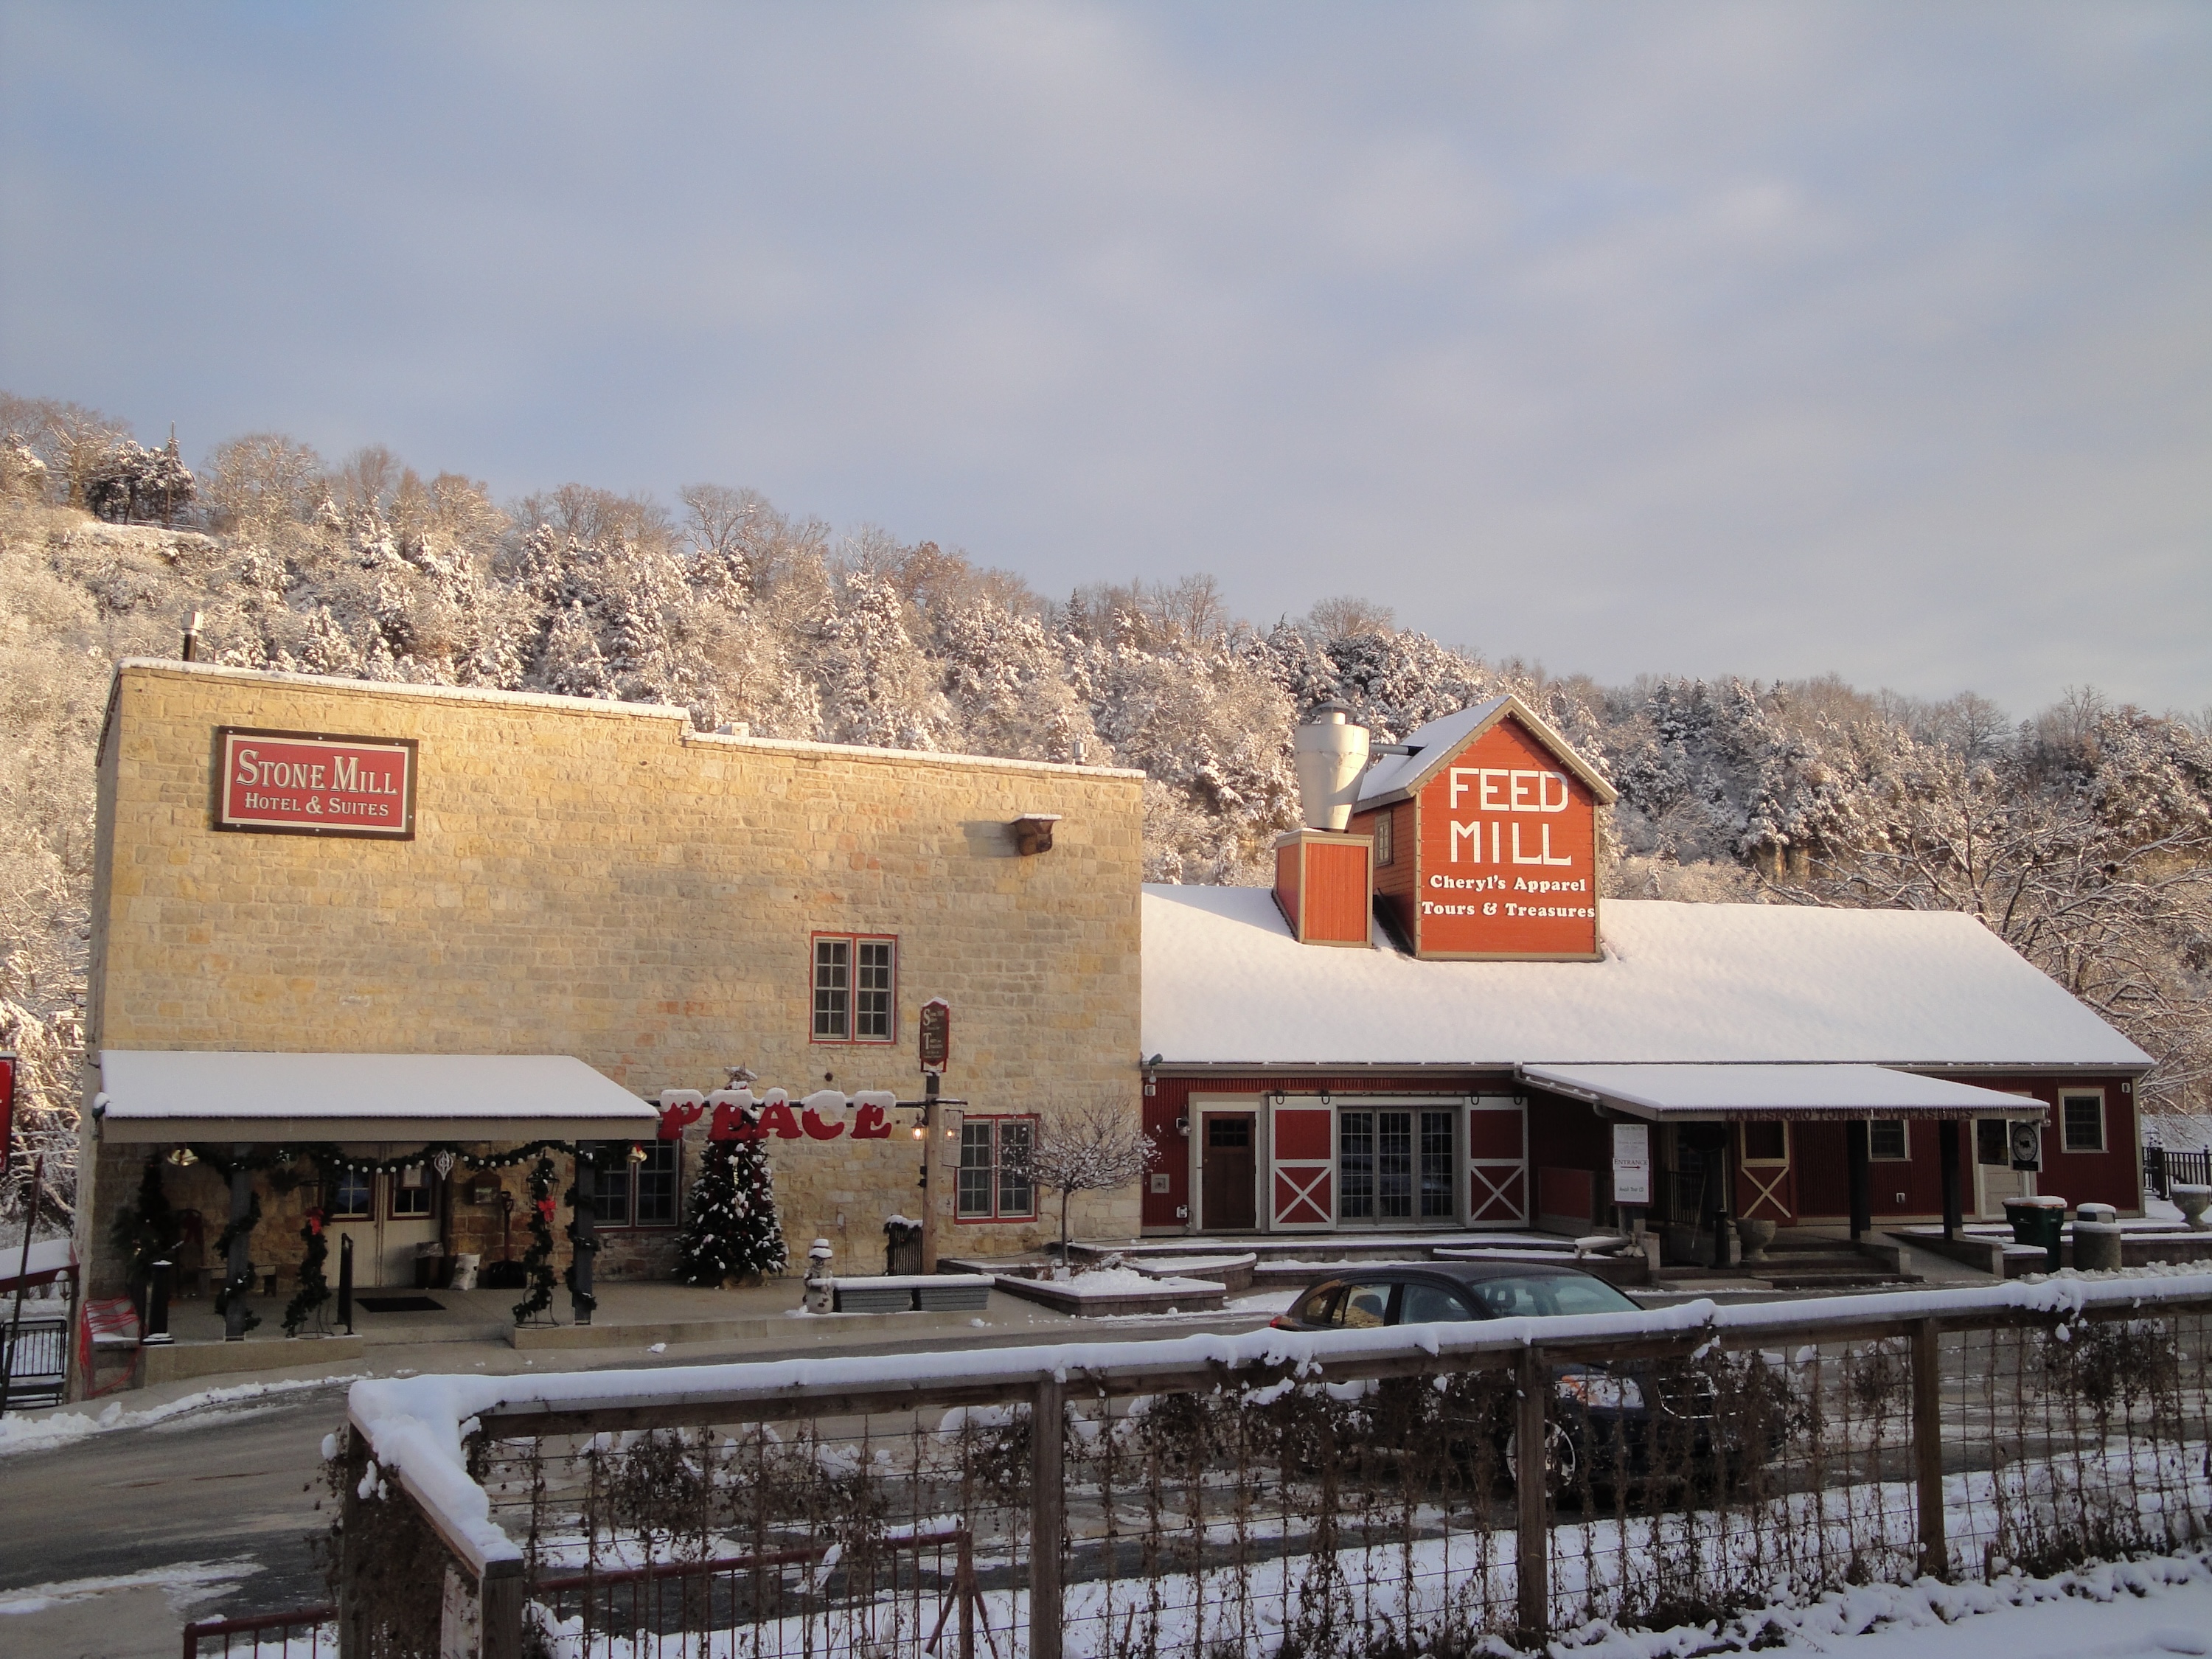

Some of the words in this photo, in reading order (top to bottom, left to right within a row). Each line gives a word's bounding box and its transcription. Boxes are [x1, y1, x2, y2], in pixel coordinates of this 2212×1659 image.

[236, 748, 326, 790] STONE
[330, 755, 398, 795] MILL
[1450, 767, 1568, 813] FEED
[245, 792, 301, 812] HOTEL
[305, 796, 324, 815] &
[328, 797, 389, 817] SUITES
[1450, 820, 1572, 866] MILL
[1430, 874, 1506, 892] Cheryl's
[1514, 877, 1586, 893] Apparel
[1422, 901, 1475, 916] Tours
[1483, 902, 1498, 916] &
[1505, 902, 1595, 917] Treasures
[657, 1088, 896, 1140] PEACE
